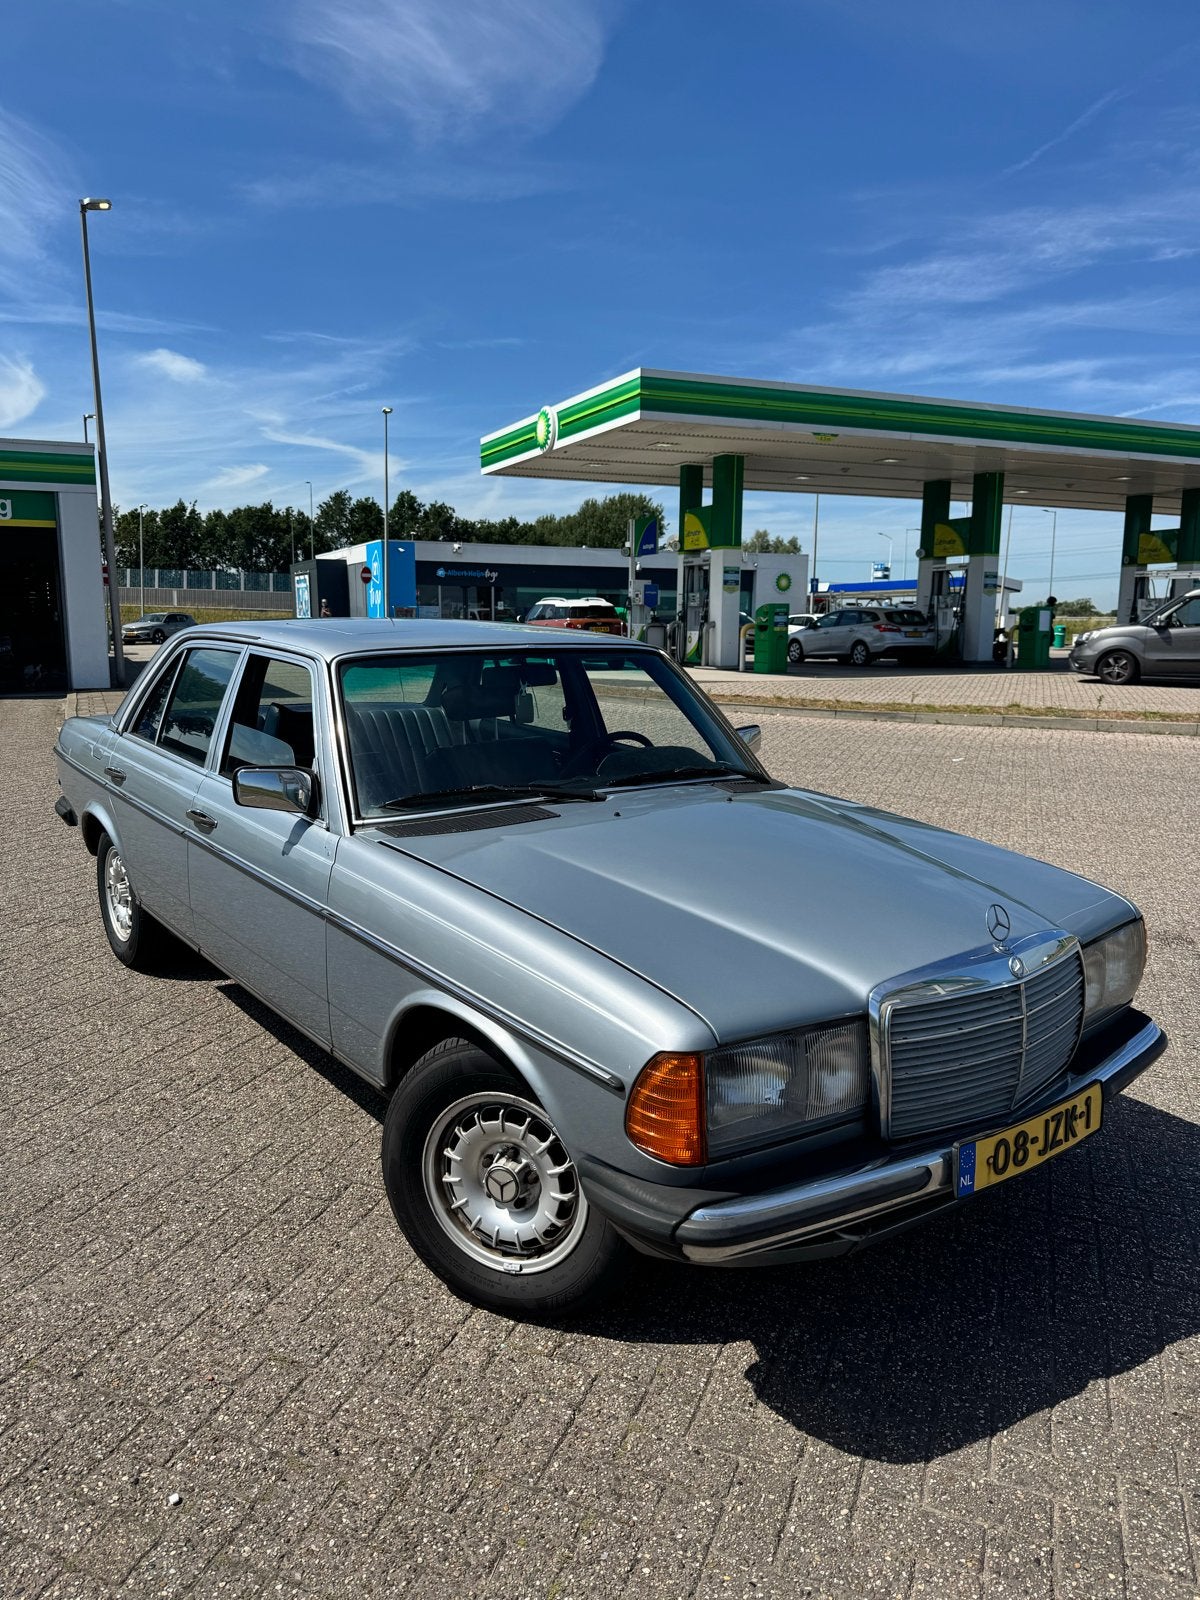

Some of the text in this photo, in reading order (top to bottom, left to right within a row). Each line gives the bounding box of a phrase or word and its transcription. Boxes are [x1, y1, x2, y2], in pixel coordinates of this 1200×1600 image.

[447, 569, 467, 577] Albert
[992, 1095, 1092, 1176] 08-JZK-1
[960, 1174, 973, 1188] NL
